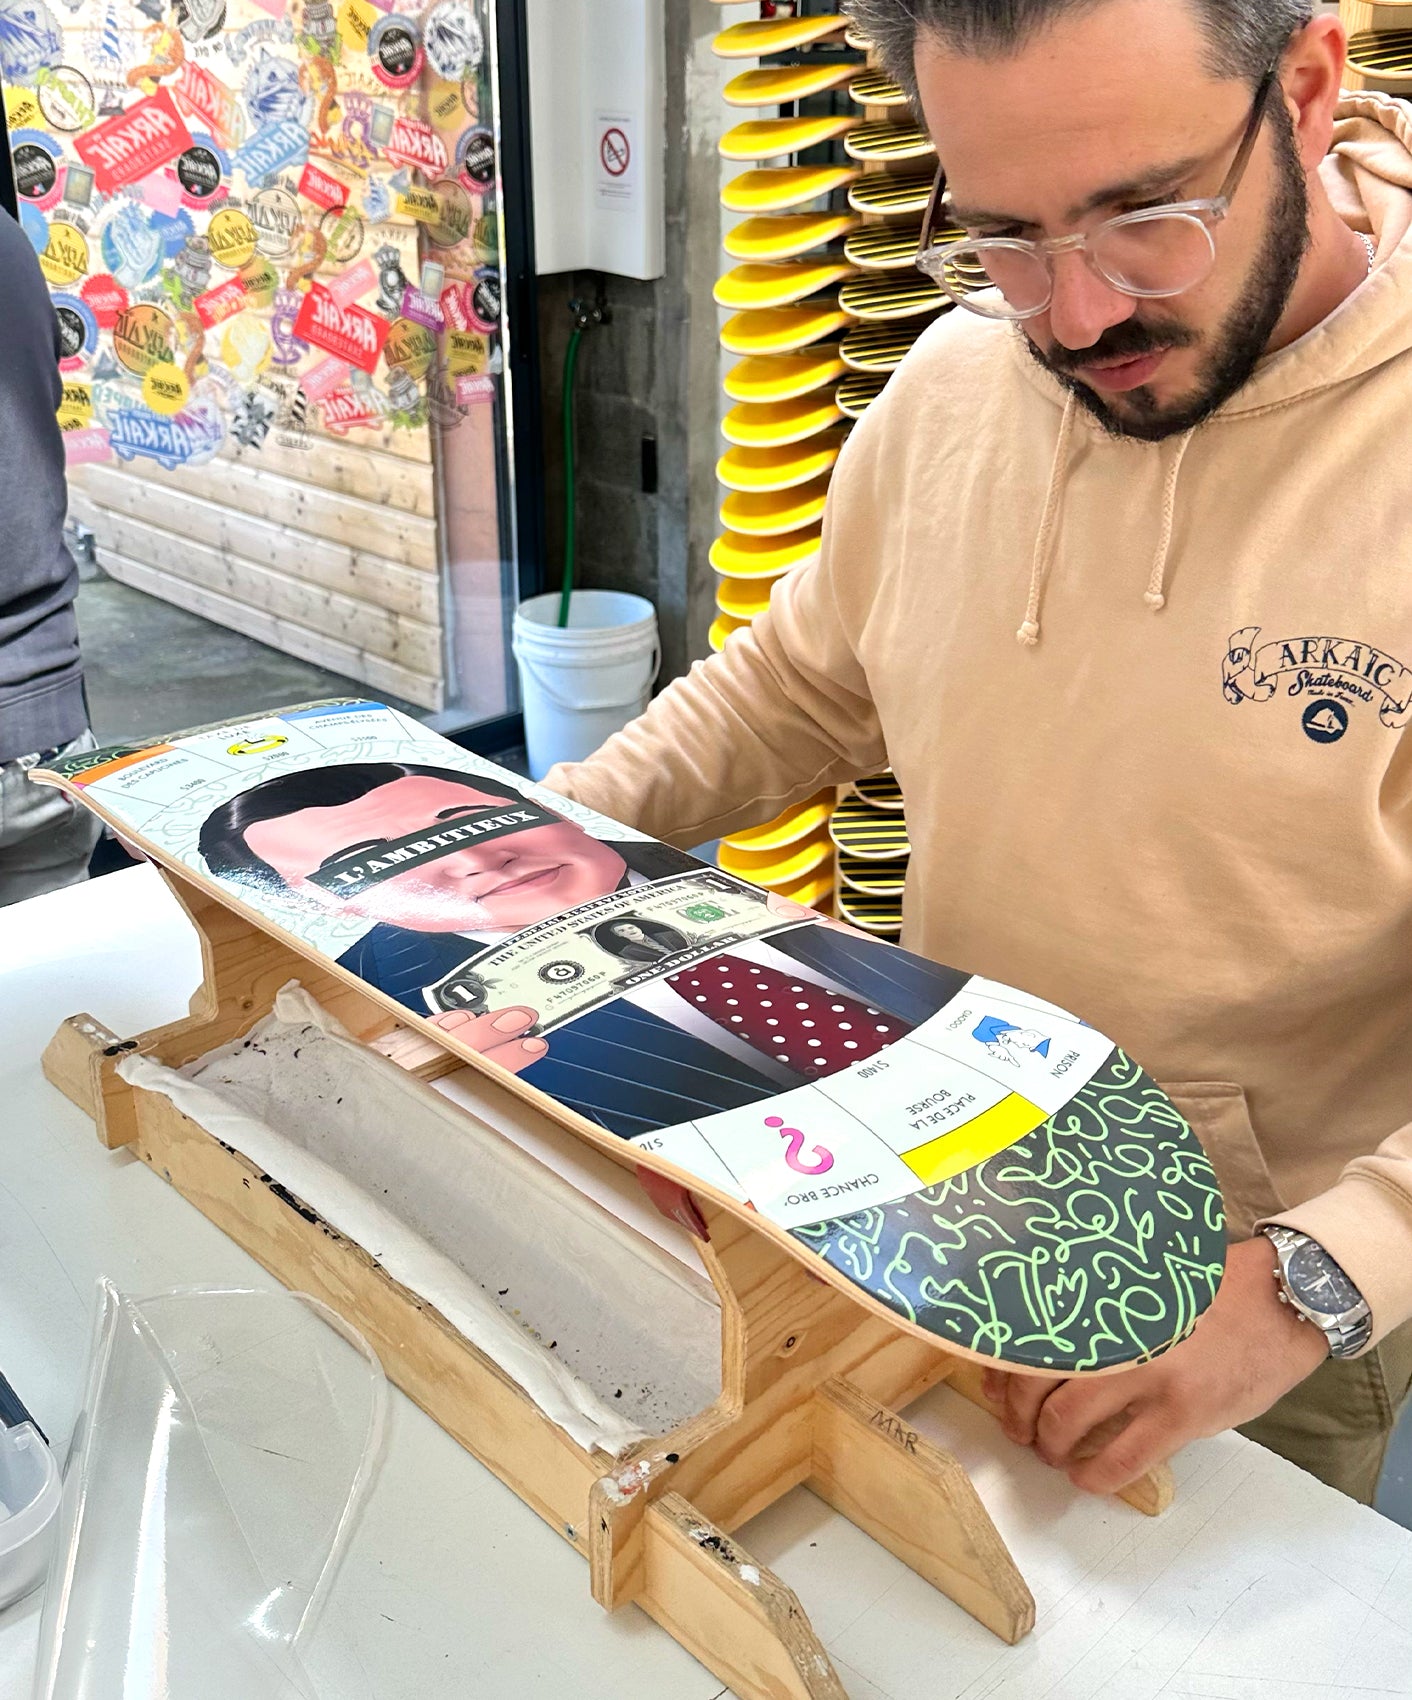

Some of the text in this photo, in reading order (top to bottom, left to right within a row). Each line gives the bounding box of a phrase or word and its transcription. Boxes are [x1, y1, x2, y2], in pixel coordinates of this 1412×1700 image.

[1280, 640, 1395, 686] ARKAIC
[1288, 670, 1373, 702] Skateboard
[489, 949, 518, 966] THE
[518, 926, 567, 950] UNITED
[568, 905, 613, 928] STATES
[614, 899, 631, 909] OF
[632, 884, 687, 904] AMERICA
[626, 936, 738, 985] ONE DOLLAR
[451, 984, 478, 1003] 1
[1050, 1050, 1080, 1079] PRISON
[905, 1089, 952, 1116] BOURSE
[908, 1093, 976, 1130] PLACE DE LA
[822, 1173, 879, 1199] CHANCE
